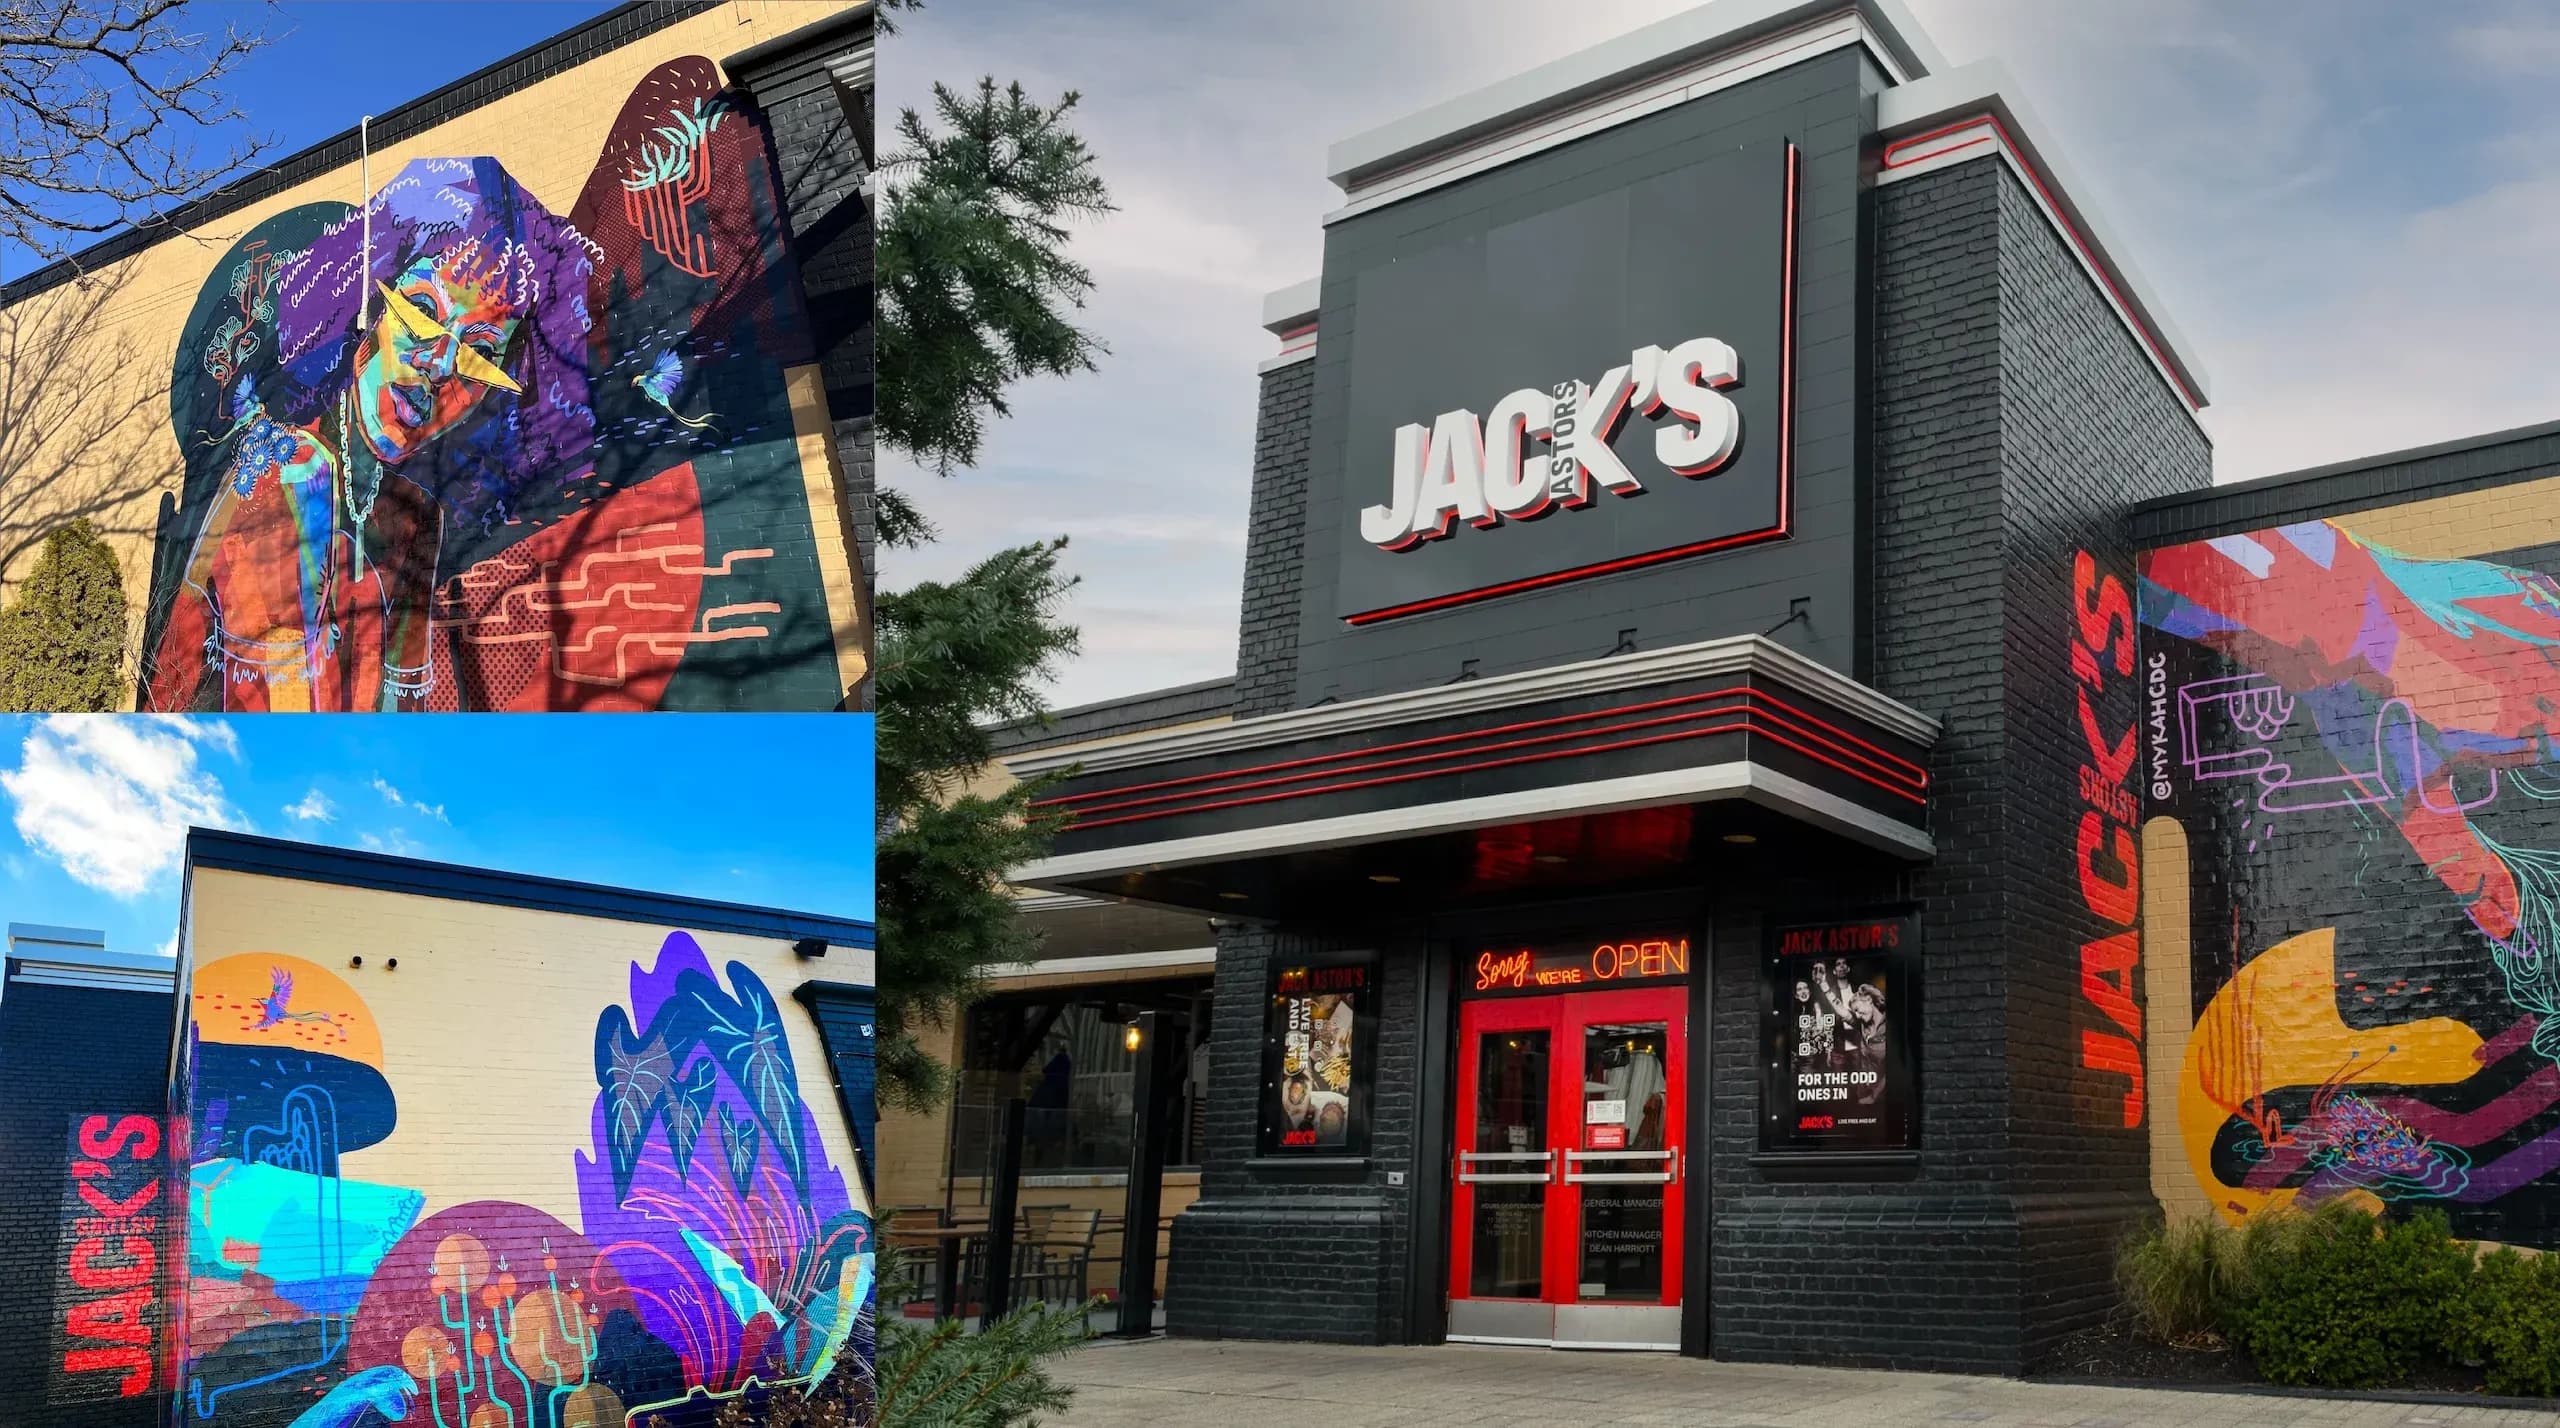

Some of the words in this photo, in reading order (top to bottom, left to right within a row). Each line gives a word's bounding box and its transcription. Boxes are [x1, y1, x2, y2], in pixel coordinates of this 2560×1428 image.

[1361, 337, 1740, 546] JACK'S
[1551, 380, 1577, 494] ASTORS
[2149, 651, 2172, 800] @MYKAHCDC
[2071, 548, 2143, 1129] JACK'S
[1780, 929, 1823, 955] JACK
[1536, 969, 1581, 985] WE'RE
[1593, 939, 1686, 979] OPEN
[1289, 998, 1299, 1030] AND
[1301, 998, 1311, 1031] LIVE
[1798, 1073, 1822, 1086] FOR
[1823, 1072, 1848, 1085] THE
[1850, 1071, 1878, 1084] ODD
[1797, 1088, 1831, 1101] ONES
[1832, 1087, 1848, 1100] IN
[1799, 1116, 1833, 1129] JACK'S
[1282, 1130, 1316, 1145] JACK'S
[1584, 1199, 1622, 1208] GENERAL
[1623, 1199, 1664, 1208] MANAGER
[1584, 1230, 1620, 1239] KITCHEN
[1621, 1230, 1662, 1240] MANAGER
[1589, 1243, 1612, 1253] DEAN
[64, 1114, 160, 1397] JACK'S
